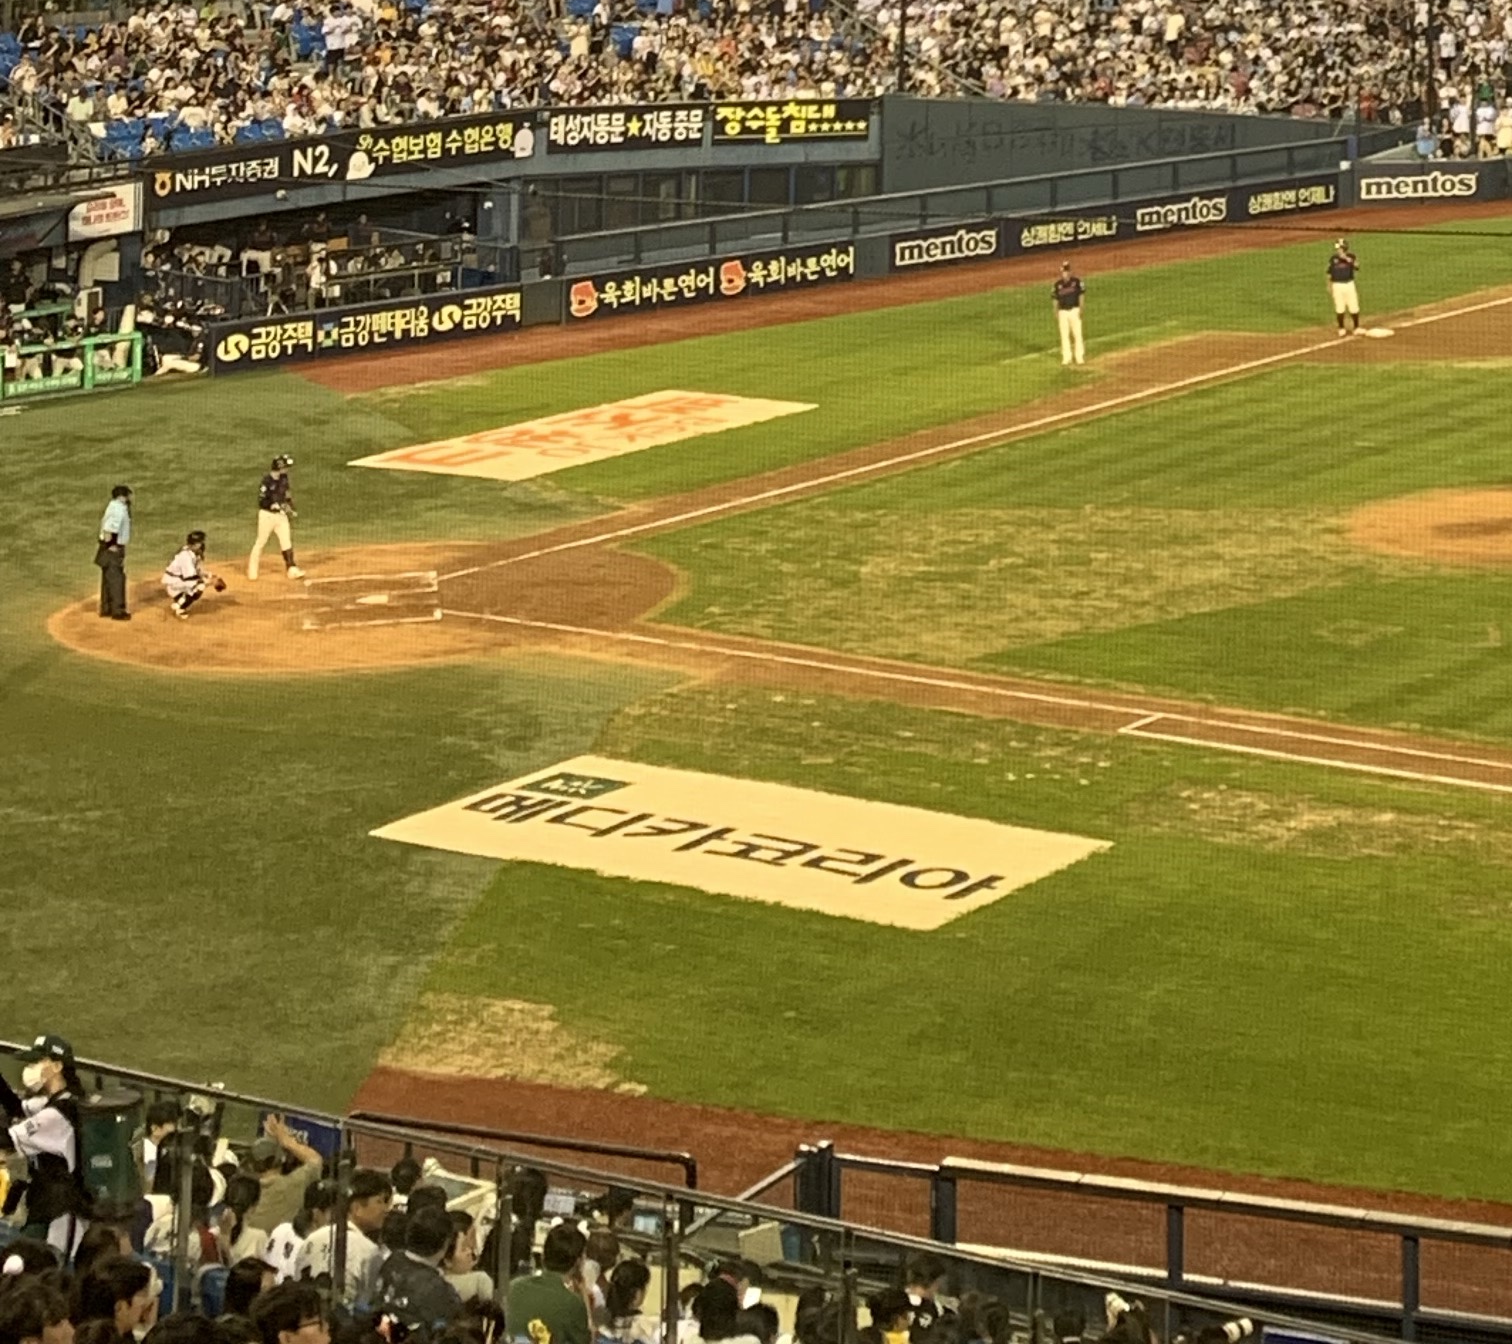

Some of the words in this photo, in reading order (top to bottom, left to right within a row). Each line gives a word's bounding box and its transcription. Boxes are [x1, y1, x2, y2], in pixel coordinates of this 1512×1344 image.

[549, 113, 626, 145] 태성자동문
[642, 109, 702, 142] 자동중문
[714, 102, 836, 144] 장수돌침대
[371, 133, 443, 165] 수협보험
[445, 123, 514, 155] 수협은행
[175, 156, 280, 193] NH투자증권
[1361, 172, 1479, 200] mentos
[1136, 195, 1227, 232] mentos
[748, 246, 855, 288] 육회바른연어
[895, 228, 997, 266] mentos
[600, 267, 715, 309] 육회바른연어
[339, 306, 430, 348] 금강펜테리움
[462, 292, 521, 330] 금강주택
[251, 320, 314, 360] 금강주택
[462, 792, 1006, 901] 메디카코리아
